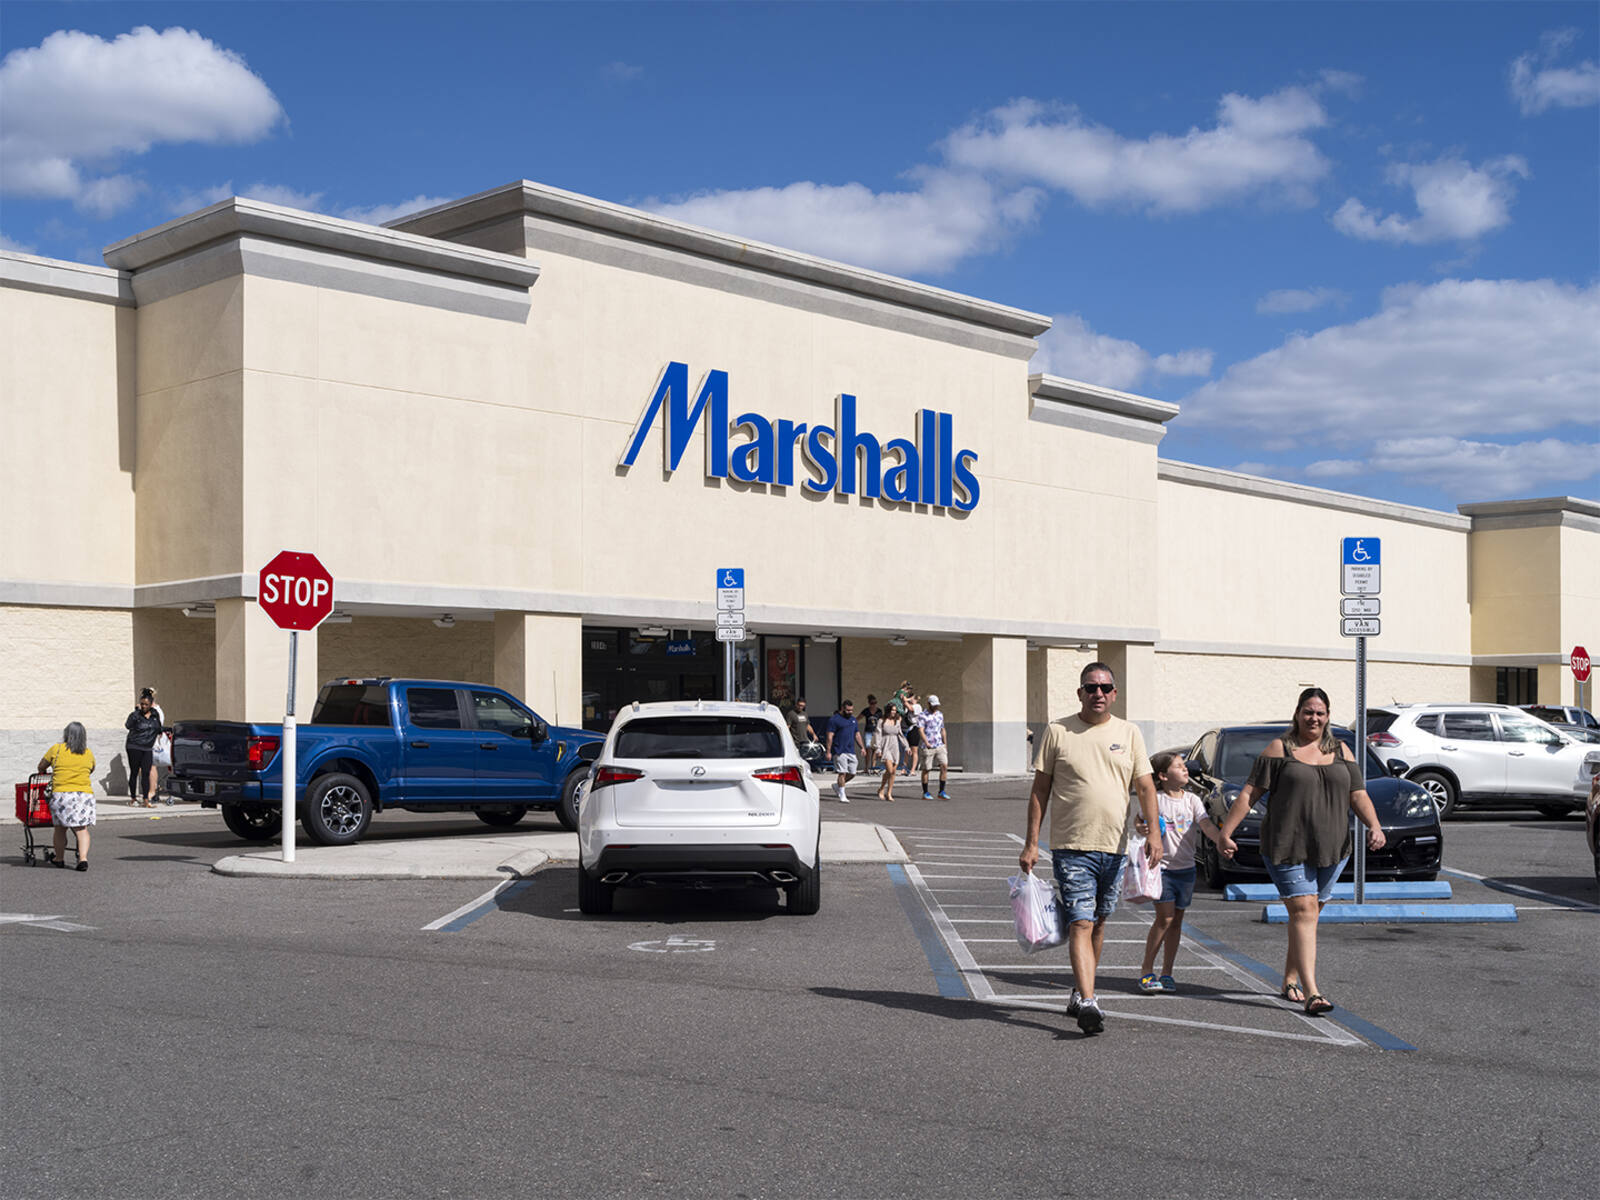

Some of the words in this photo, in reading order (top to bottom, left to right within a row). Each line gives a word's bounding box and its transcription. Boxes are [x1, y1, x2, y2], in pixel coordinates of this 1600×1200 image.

[619, 361, 980, 512] Marshalls
[263, 573, 329, 607] STOP
[1571, 656, 1590, 671] STOP
